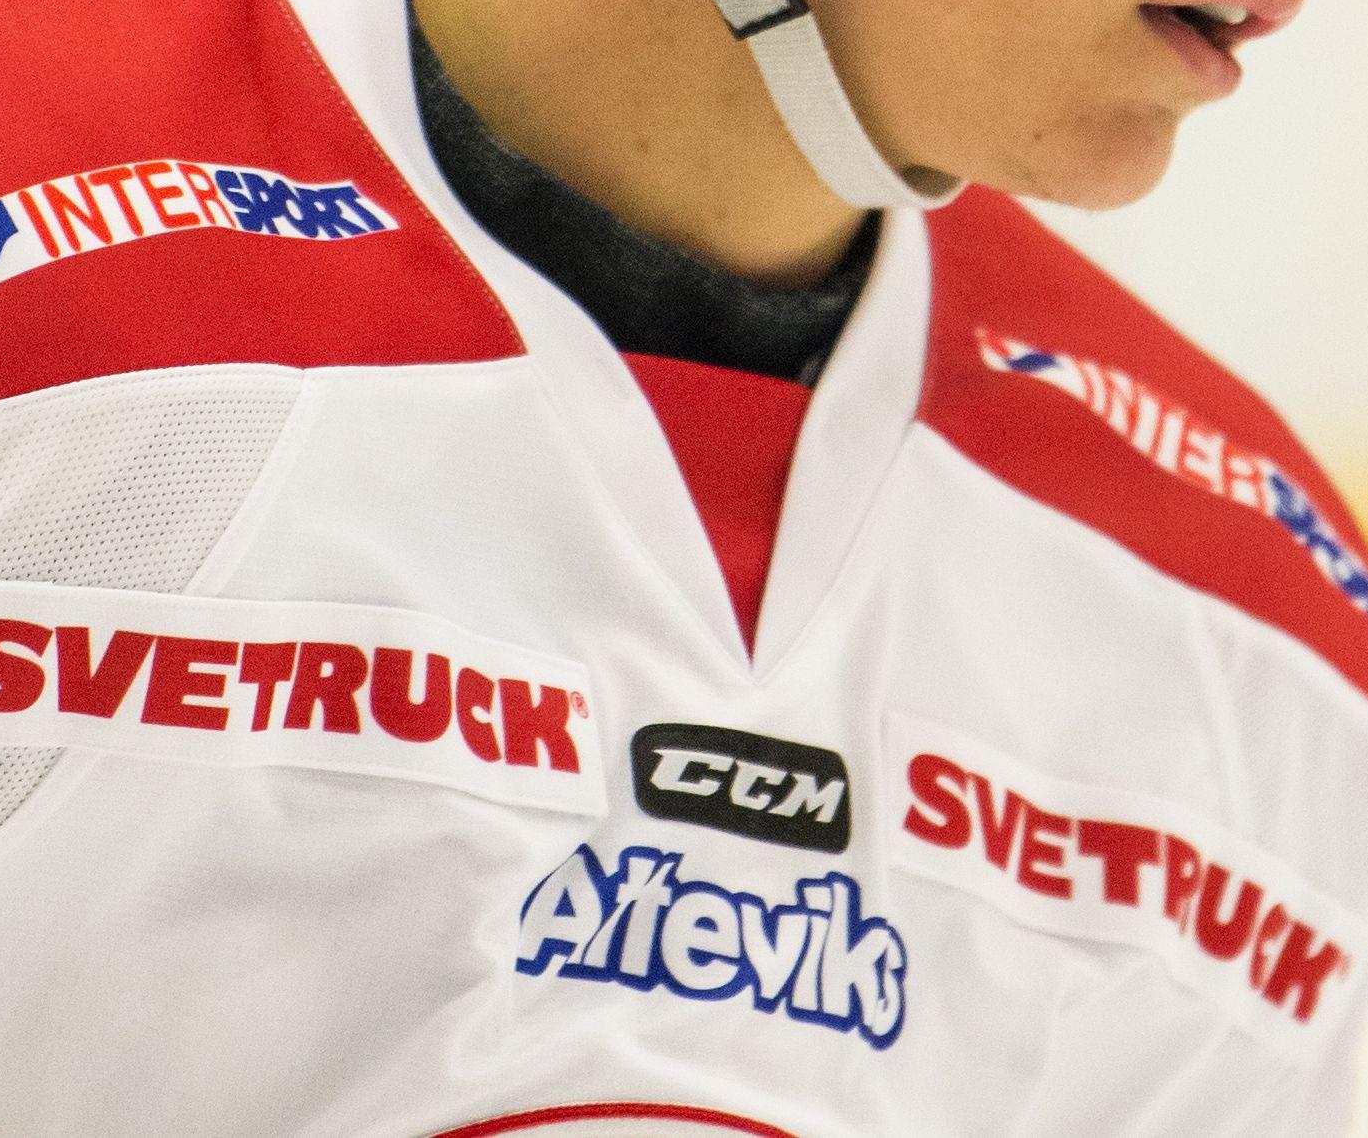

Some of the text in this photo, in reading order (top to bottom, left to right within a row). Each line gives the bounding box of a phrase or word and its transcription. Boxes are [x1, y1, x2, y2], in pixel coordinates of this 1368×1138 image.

[17, 161, 388, 259] INTERSPORT
[650, 748, 846, 824] CCM
[515, 842, 909, 1051] Atteviks
